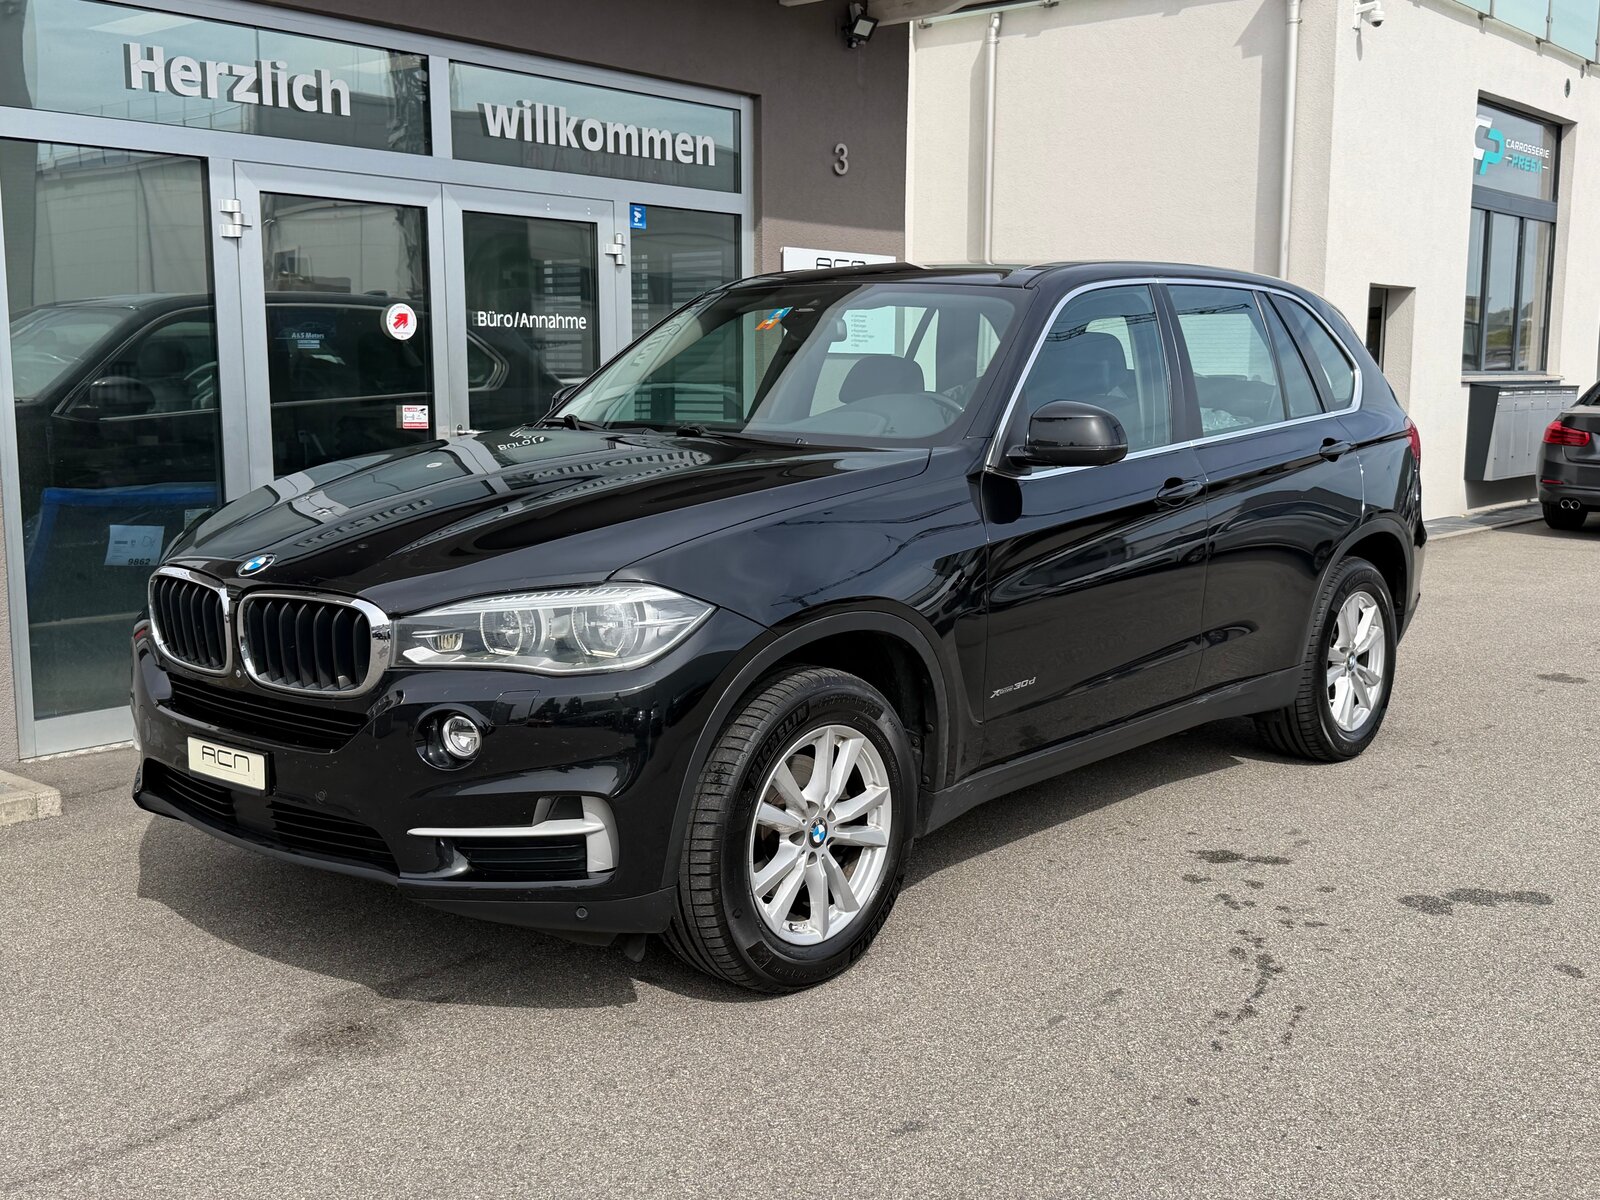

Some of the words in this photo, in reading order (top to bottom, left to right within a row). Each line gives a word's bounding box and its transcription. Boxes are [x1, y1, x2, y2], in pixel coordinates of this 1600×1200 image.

[127, 42, 351, 117] Herzlich
[482, 99, 716, 167] willkommen
[834, 143, 849, 175] 3
[1505, 138, 1550, 159] CARROSSERIE
[477, 310, 587, 330] Büro/Annahme
[127, 558, 151, 566] 9862
[202, 745, 250, 772] ACN
[748, 705, 809, 786] MICHELIN
